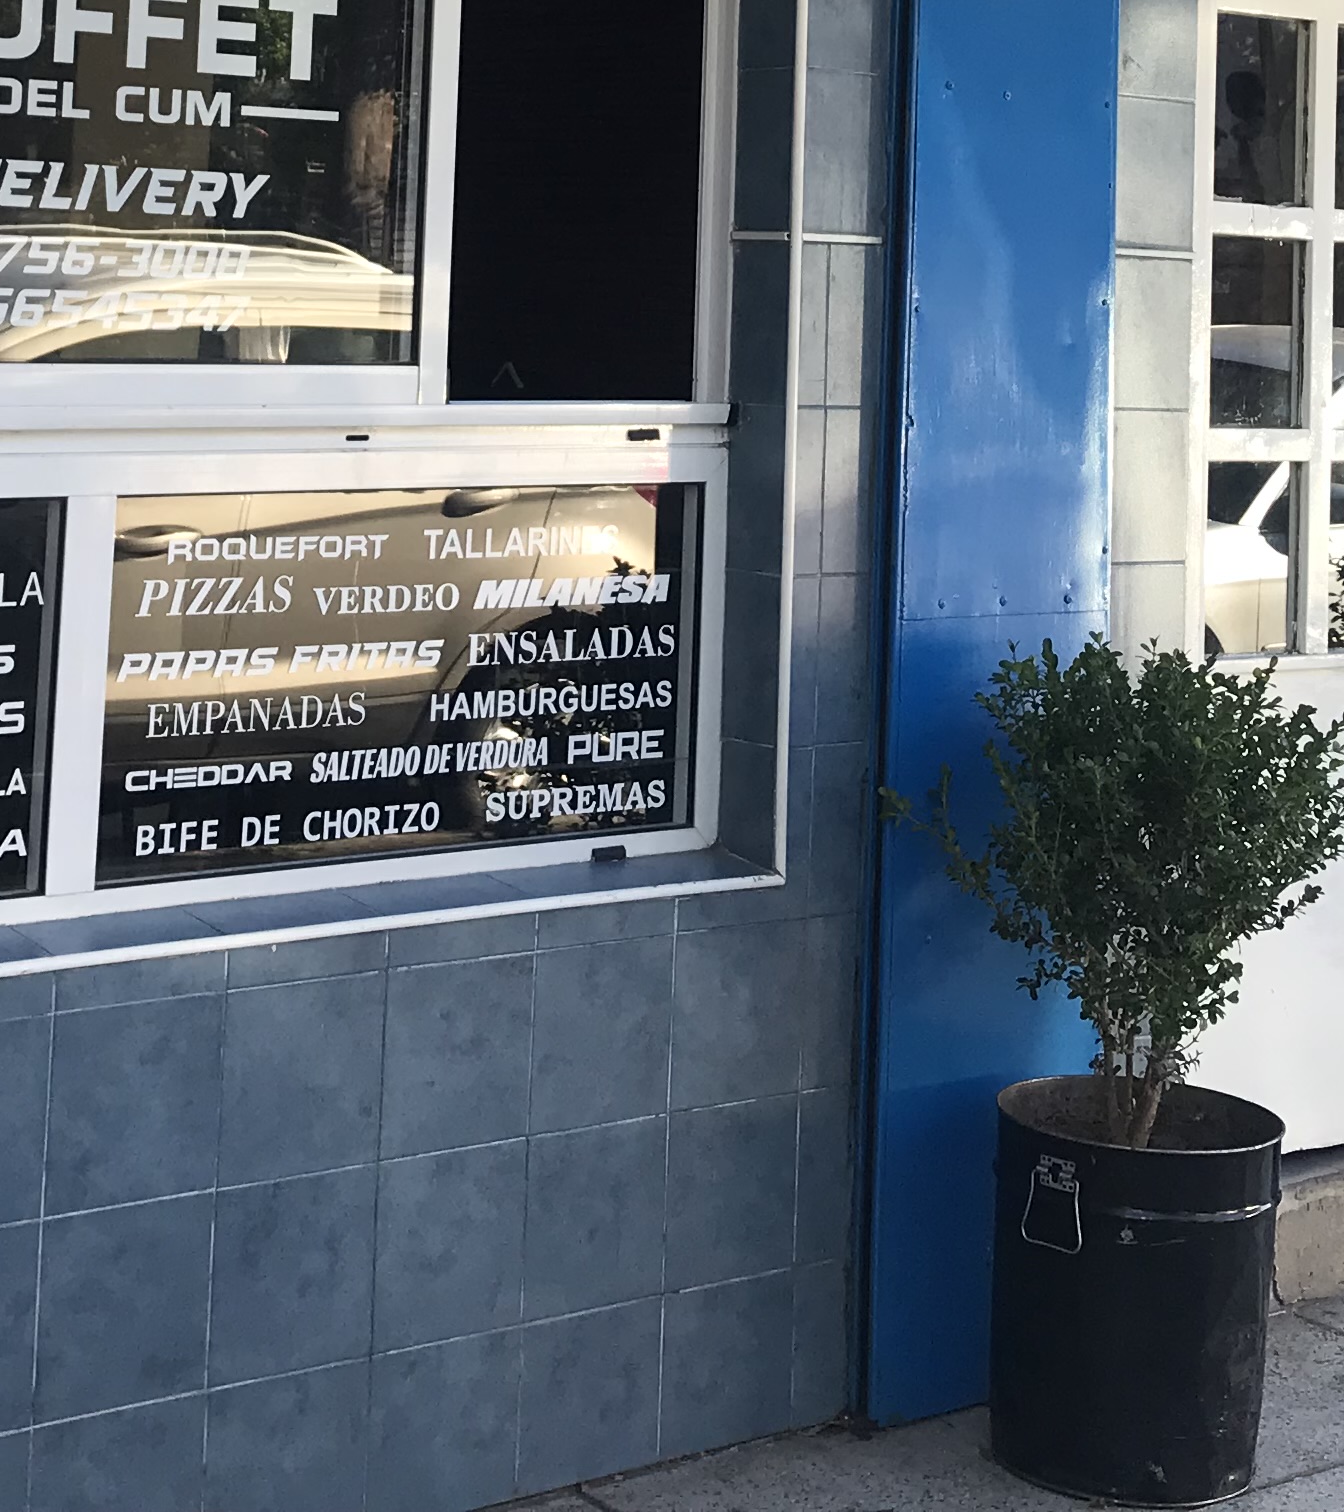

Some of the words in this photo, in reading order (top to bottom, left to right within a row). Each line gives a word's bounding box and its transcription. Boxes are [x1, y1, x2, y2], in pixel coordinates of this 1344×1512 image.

[115, 85, 232, 128] CUM
[167, 534, 389, 565] ROQUEFORT
[135, 575, 294, 617] PIZZAS
[312, 583, 460, 616] VERDEO
[473, 573, 671, 610] MILANESA
[116, 646, 279, 683] PAPAS
[288, 638, 445, 674] FRITAS
[467, 624, 675, 667] ENSALADAS
[145, 691, 366, 739] EMPANADAS
[429, 680, 673, 722] HAMBURGUESAS
[125, 760, 293, 792] CHEDDAR
[309, 745, 420, 784] SALTEADO
[423, 743, 453, 775] DE
[456, 736, 548, 773] VERDURA
[567, 729, 665, 765] PURE
[135, 818, 219, 857] BIFE
[240, 813, 282, 848] DE
[303, 800, 440, 843] CHORIZO
[485, 779, 666, 823] SUPREMAS
